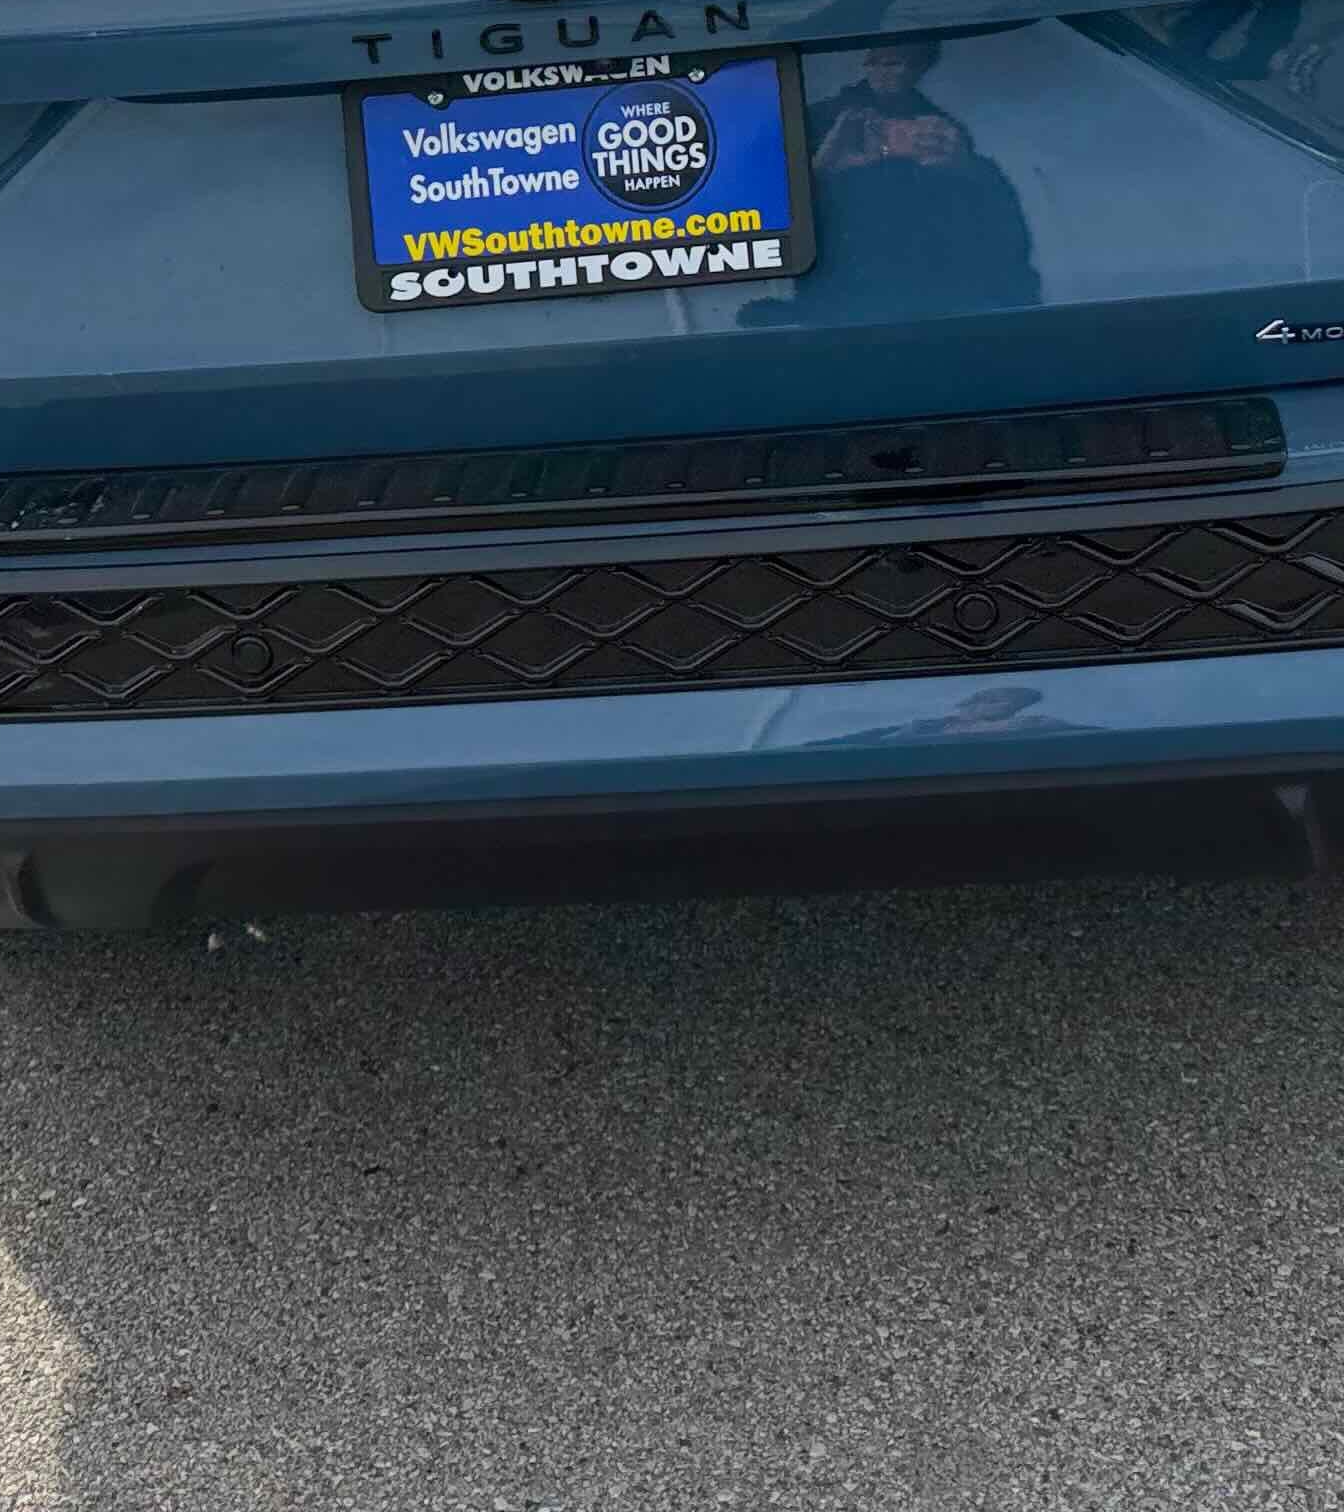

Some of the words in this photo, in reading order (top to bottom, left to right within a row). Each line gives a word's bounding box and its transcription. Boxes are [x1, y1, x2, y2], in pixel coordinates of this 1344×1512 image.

[352, 0, 750, 65] TIGUAN
[462, 55, 672, 94] VOLKSWEN
[620, 101, 672, 119] WHERE
[402, 121, 577, 159] Volkswagen
[597, 115, 698, 150] GOOD
[592, 142, 707, 178] THINGS
[409, 166, 580, 205] SouthTowne
[624, 174, 681, 192] HAPPEN
[403, 208, 763, 263] VWSouthtowne.com
[389, 238, 783, 302] SOUTHTOWNE
